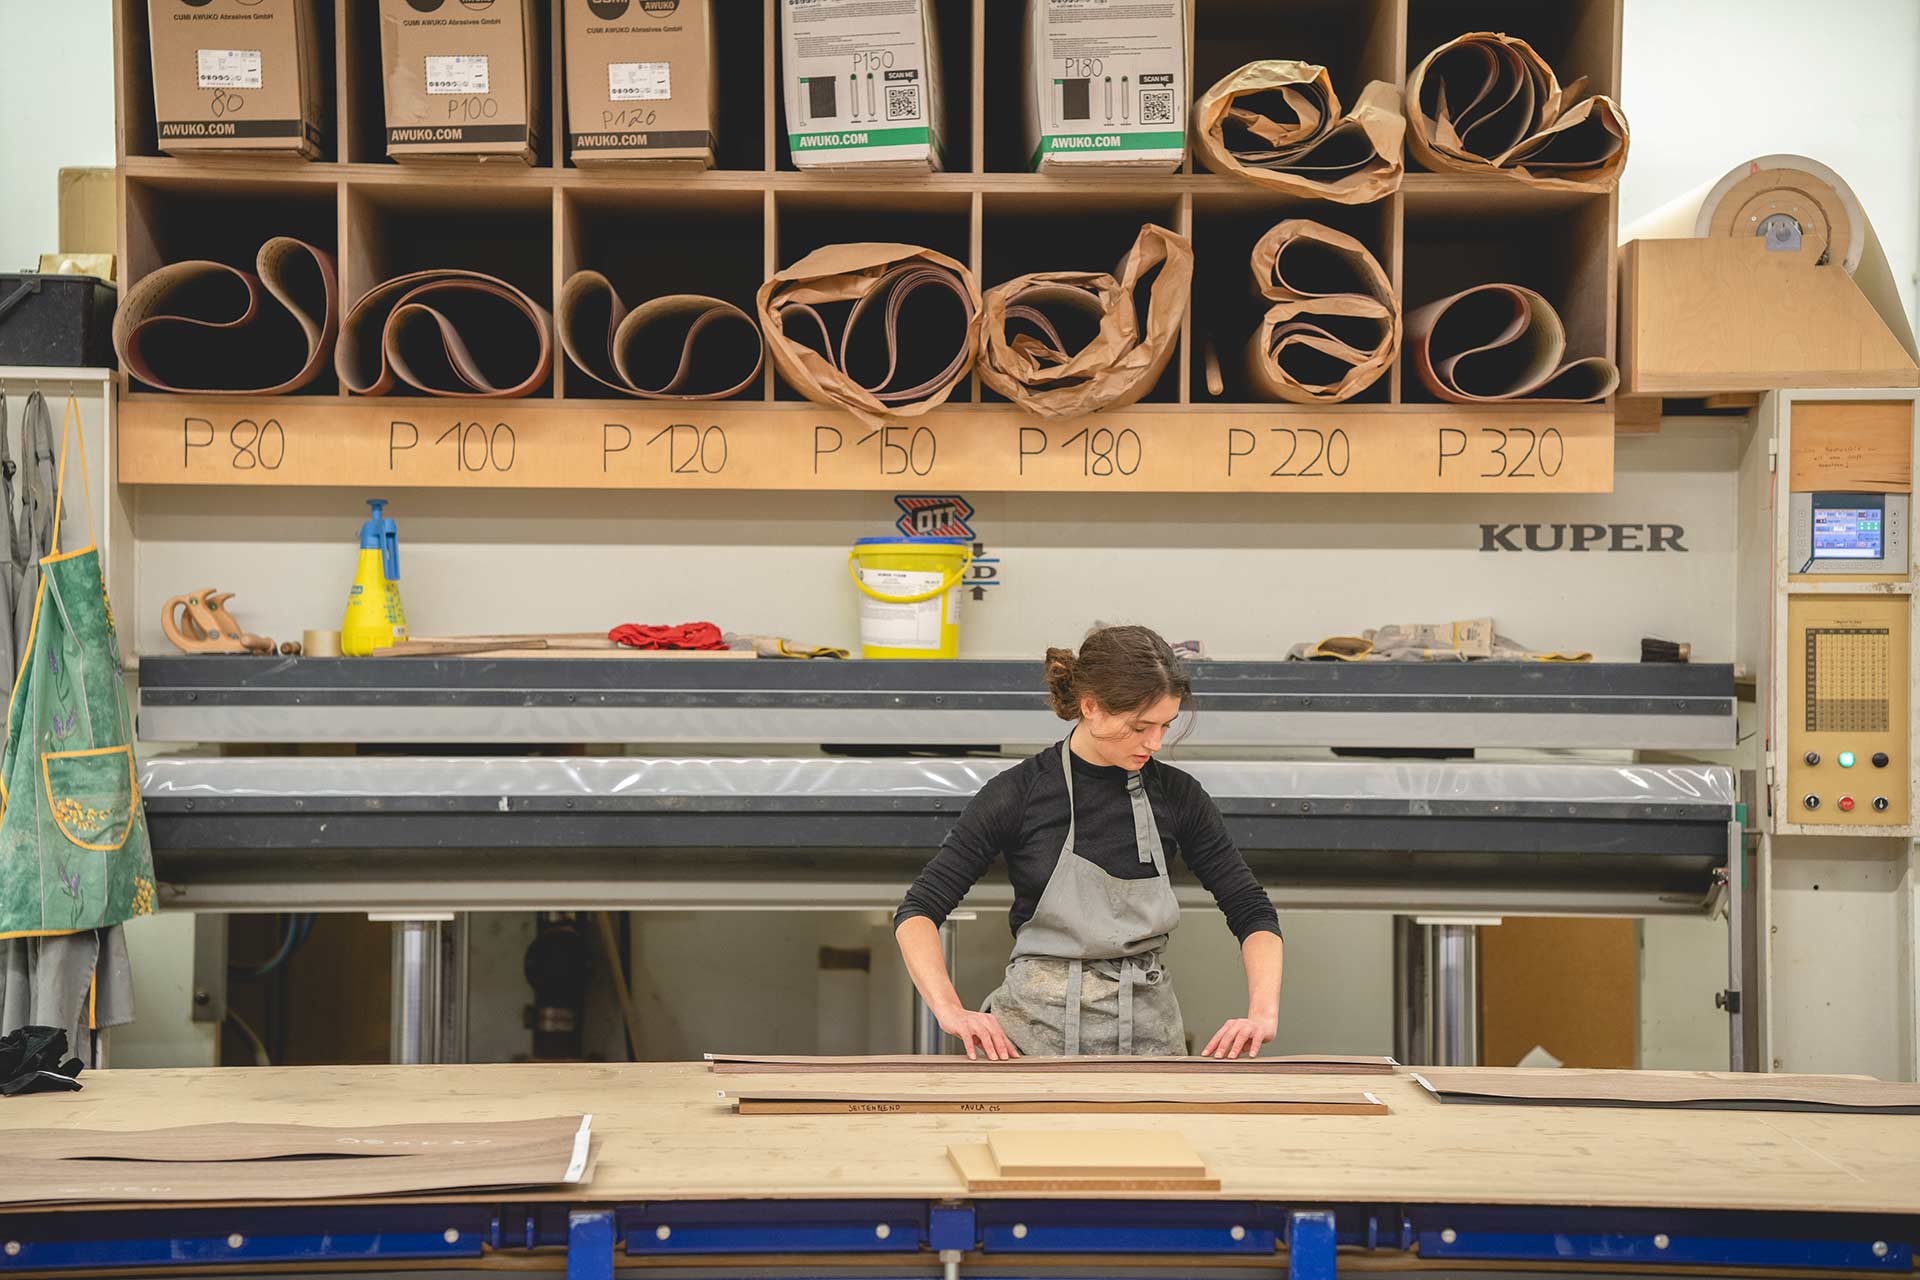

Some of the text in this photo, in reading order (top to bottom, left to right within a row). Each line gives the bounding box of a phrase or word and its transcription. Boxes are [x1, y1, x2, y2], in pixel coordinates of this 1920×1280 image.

[644, 1, 675, 10] AWUKO
[853, 51, 895, 71] P150
[1065, 58, 1103, 77] P180
[1143, 75, 1159, 83] SCAN
[211, 88, 244, 117] 80
[448, 96, 498, 121] P100
[163, 123, 235, 136] AWUKO.COM
[391, 129, 462, 141] AWUKO.COM
[577, 134, 647, 147] AWUKO.COM
[799, 133, 868, 147] AWUKO.COM
[1051, 136, 1120, 149] AWUKO.COM
[184, 418, 285, 470] P 80
[390, 421, 516, 472] P 100
[604, 424, 728, 474] P 120
[814, 426, 937, 476] P 150
[1018, 428, 1142, 476] P 180
[1228, 428, 1350, 477] P 220
[1439, 428, 1565, 478] P 320
[914, 505, 957, 534] OTT
[1479, 524, 1689, 552] KUPER
